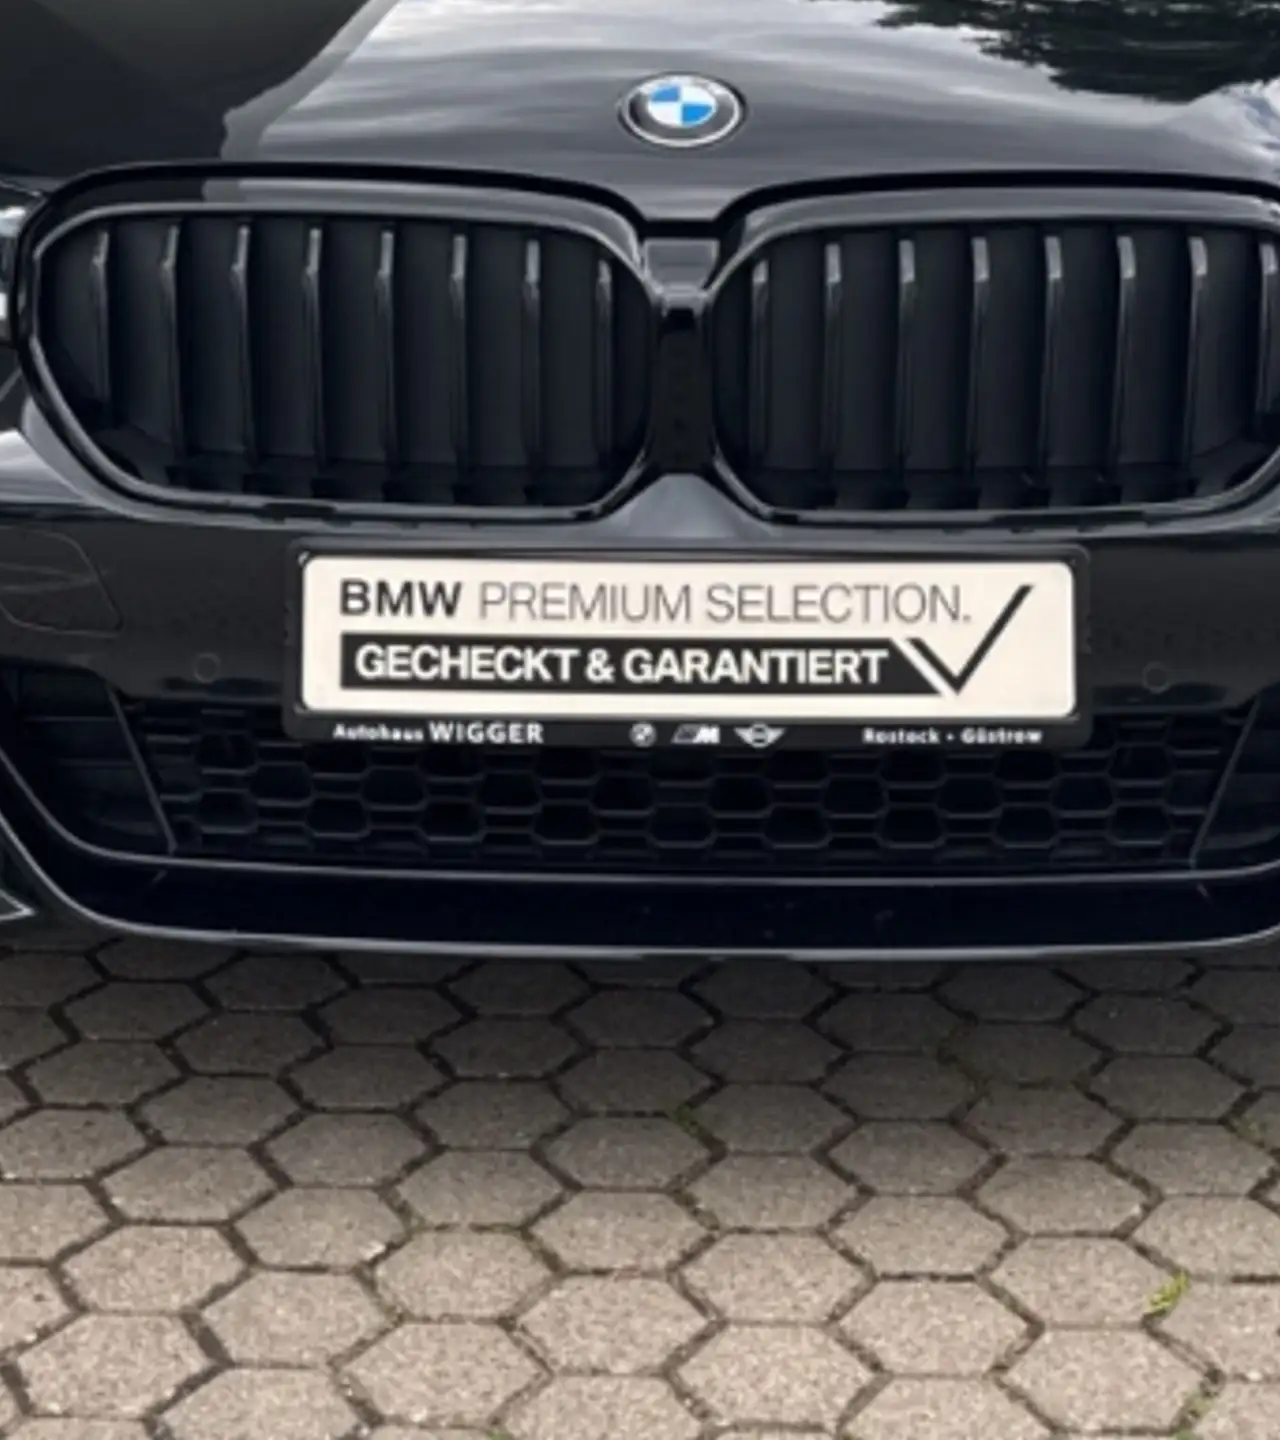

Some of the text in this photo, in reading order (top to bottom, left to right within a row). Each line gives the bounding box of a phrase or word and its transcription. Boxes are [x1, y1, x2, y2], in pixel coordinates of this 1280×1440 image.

[340, 578, 972, 624] BMW PREMIUM SELECTION.
[355, 643, 889, 685] GECHECKT & GARANTIERT
[333, 721, 544, 744] Autohaus WIGGER
[862, 727, 1043, 744] Rostock Güstrow
